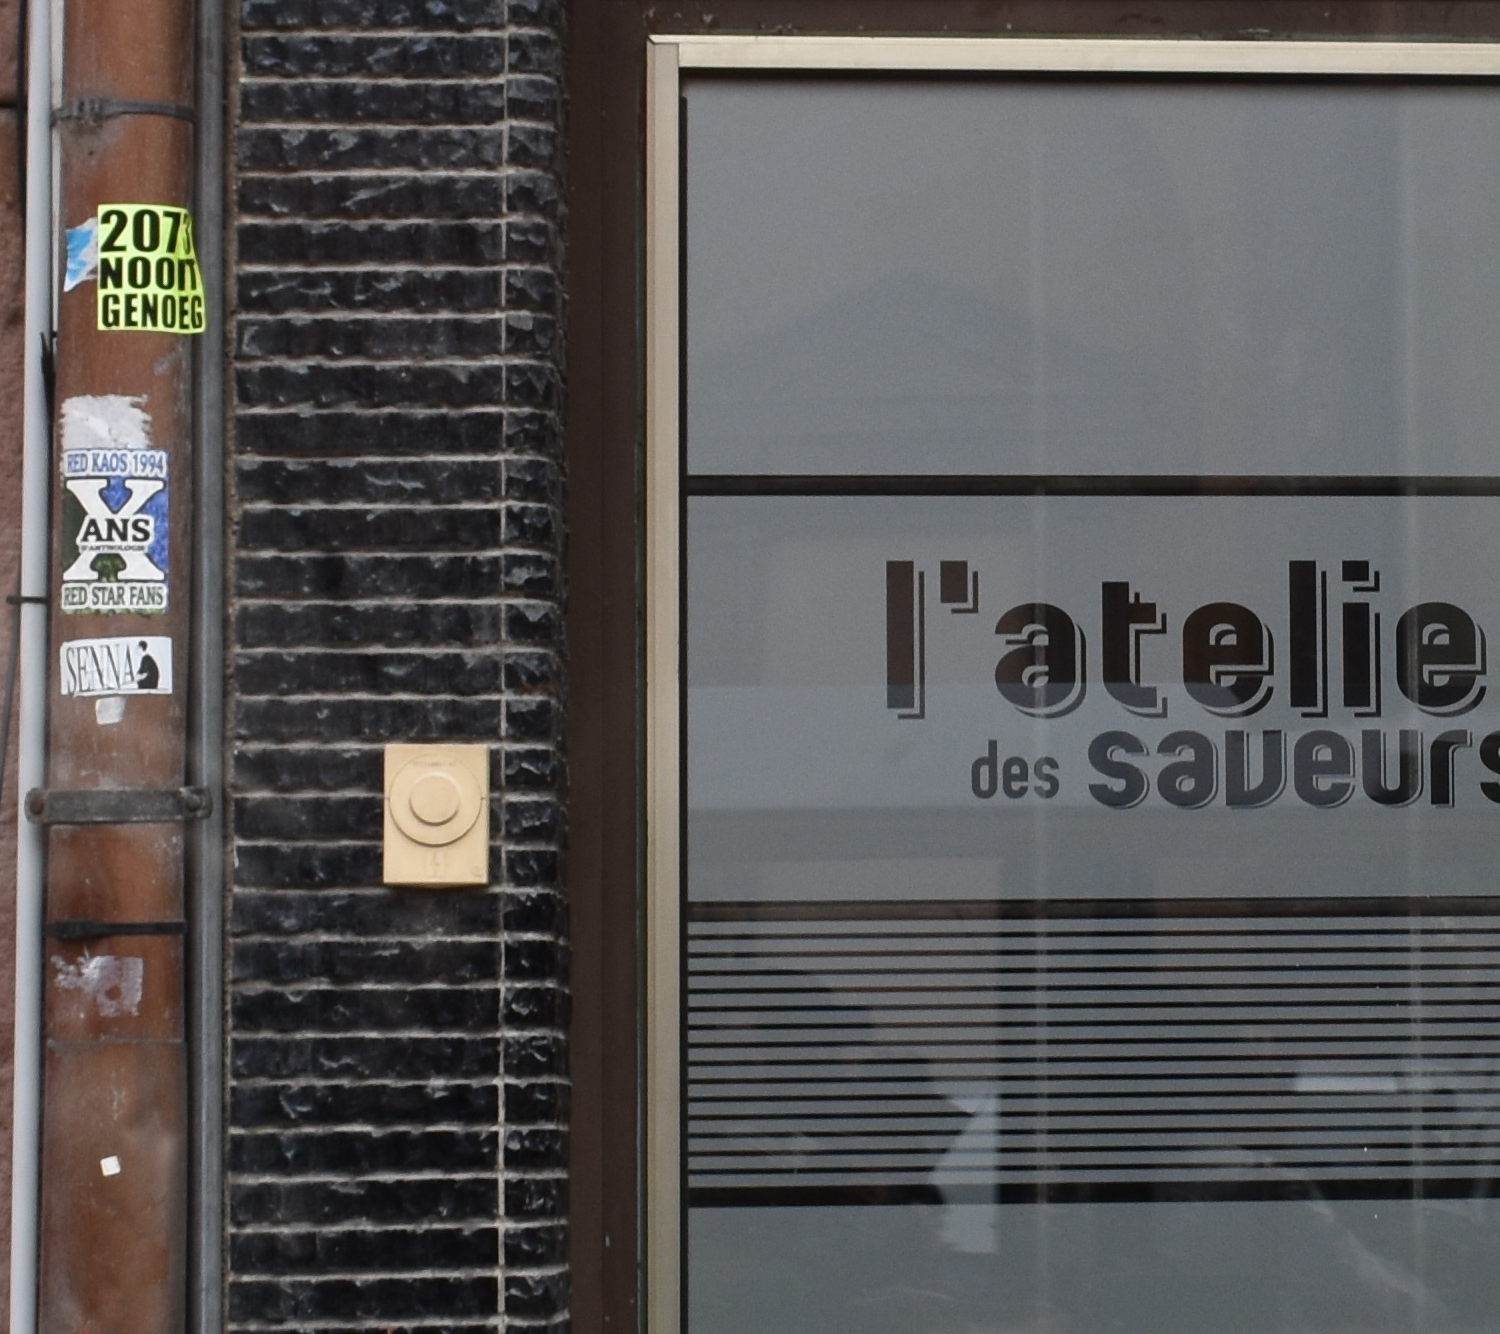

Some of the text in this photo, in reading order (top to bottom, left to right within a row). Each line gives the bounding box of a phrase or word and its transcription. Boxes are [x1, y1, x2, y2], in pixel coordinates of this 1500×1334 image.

[100, 209, 191, 255] 2073
[100, 256, 197, 291] NOOIT
[101, 293, 203, 329] GENOEG
[67, 453, 164, 474] RED KAOS 1994
[80, 518, 151, 543] ANS
[63, 585, 164, 606] RED STAR FANS
[970, 738, 1061, 800] des
